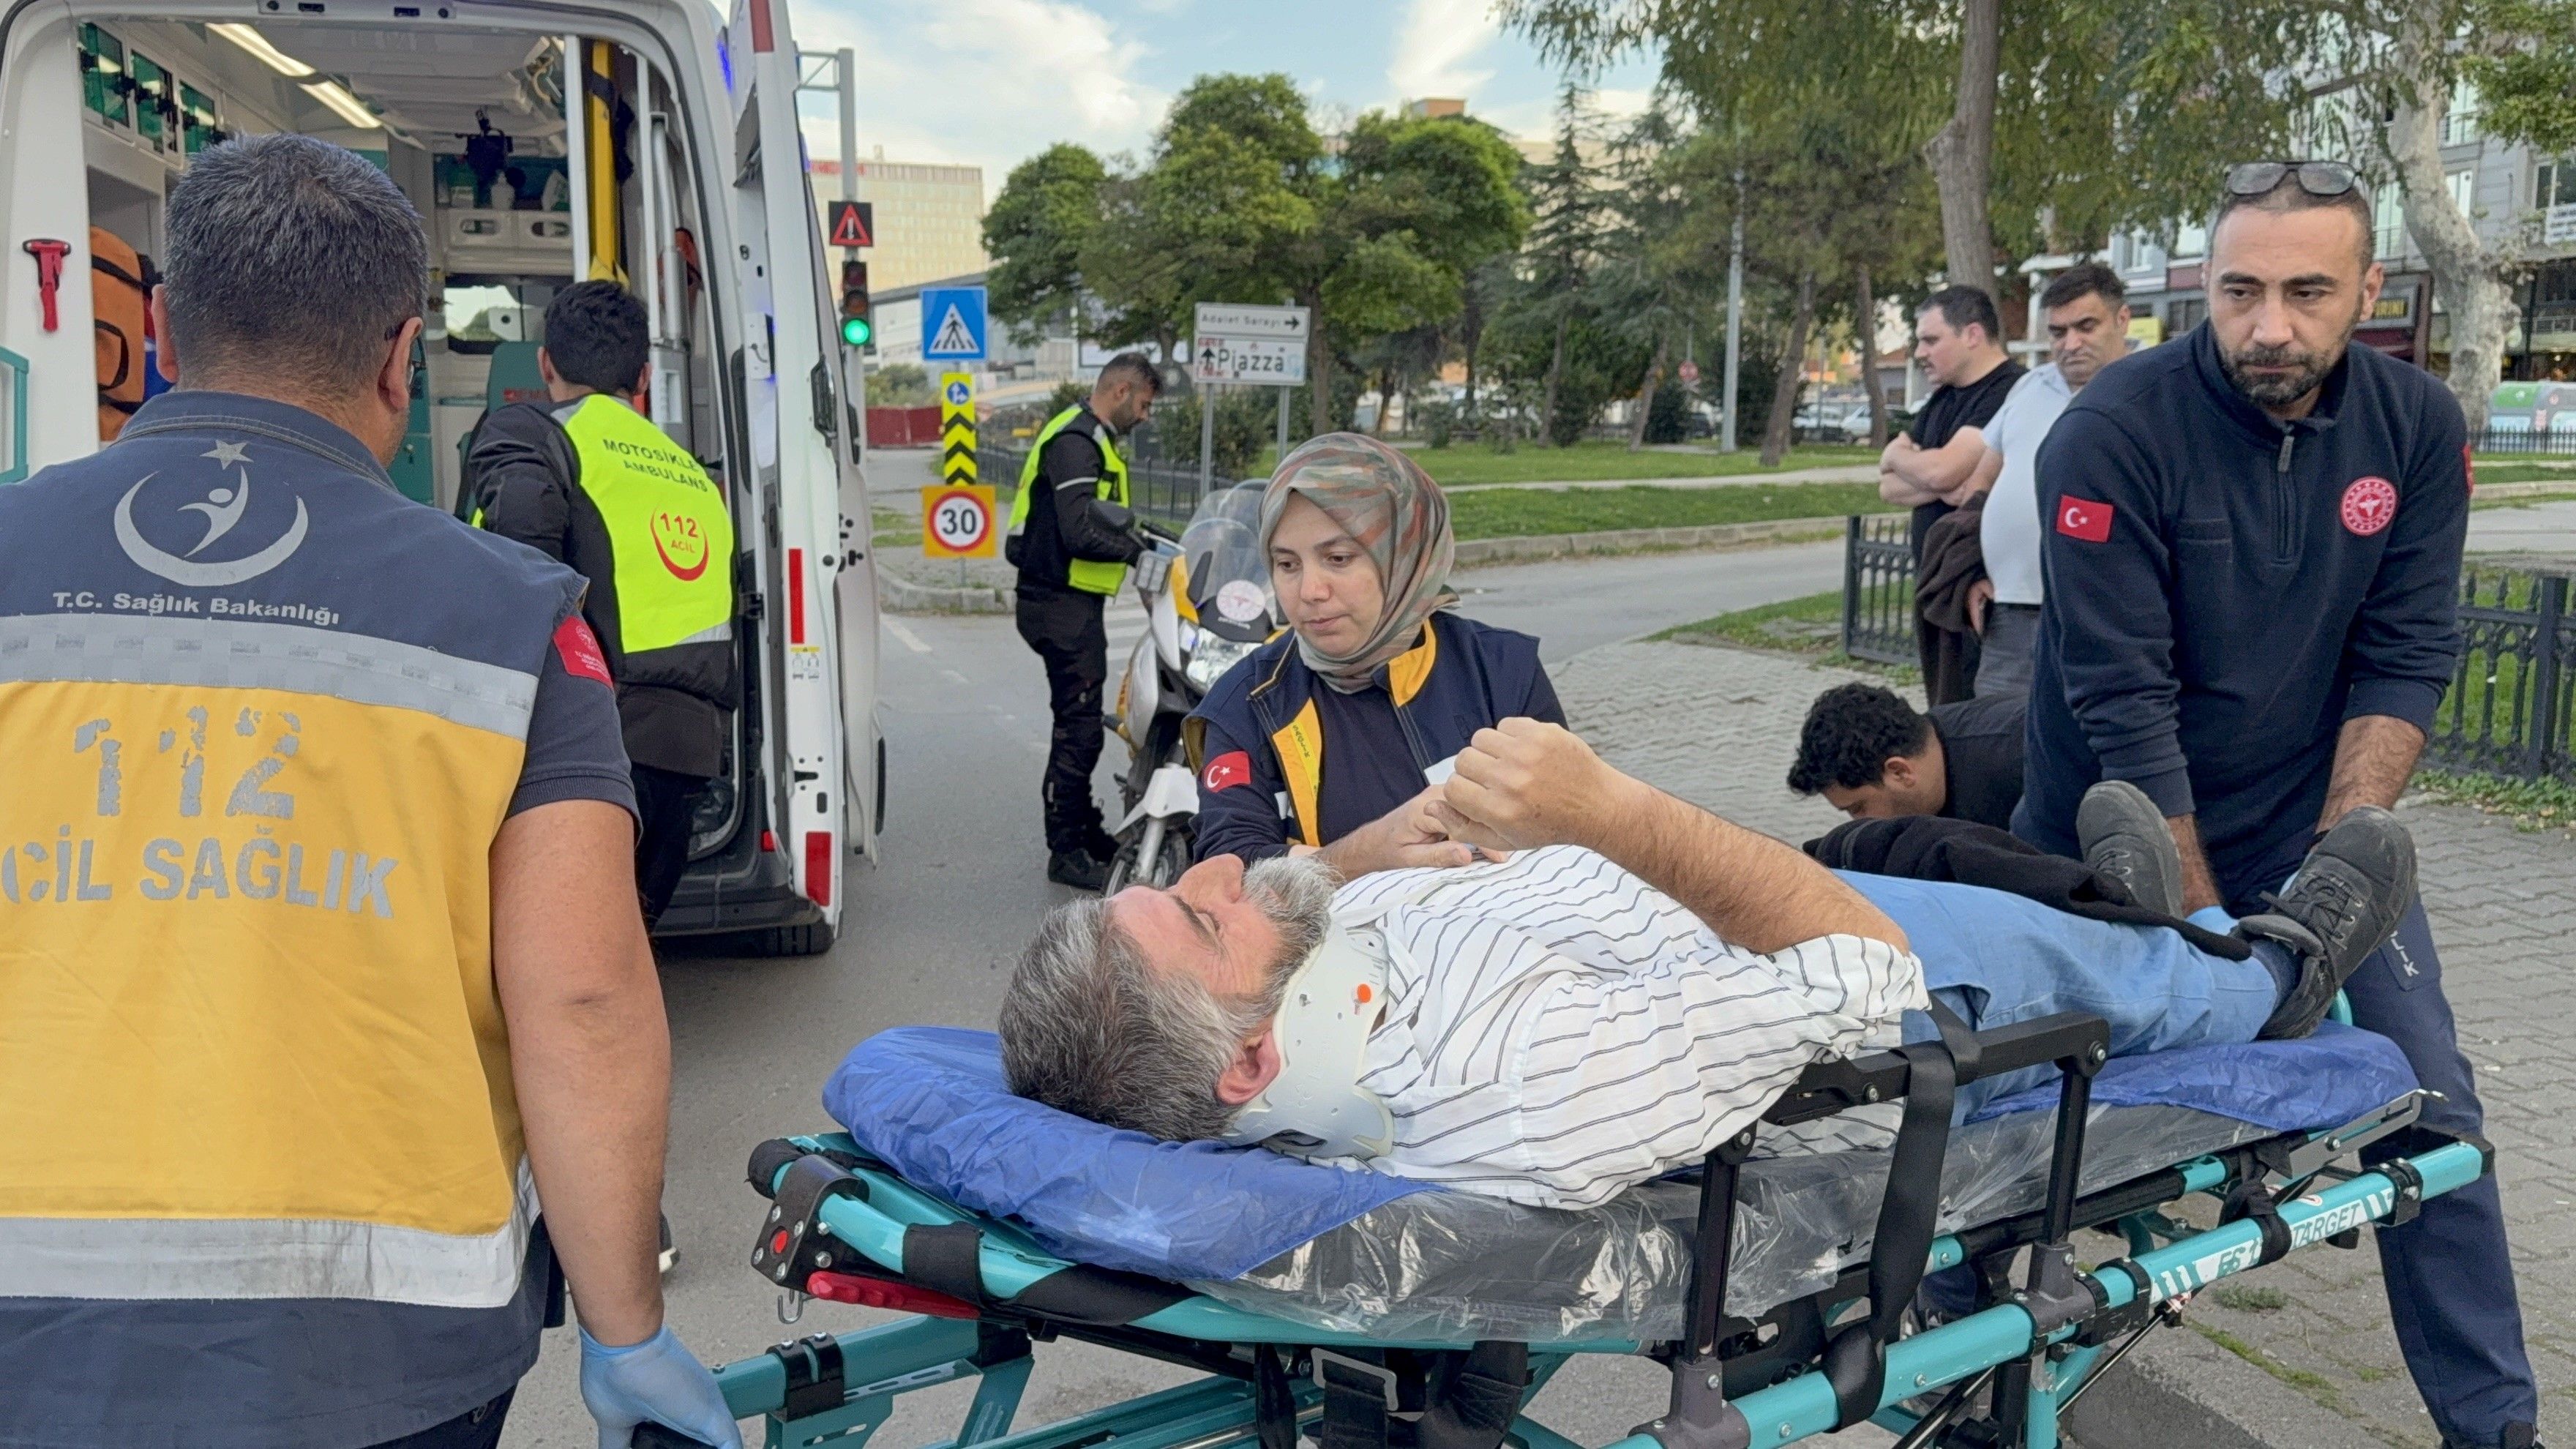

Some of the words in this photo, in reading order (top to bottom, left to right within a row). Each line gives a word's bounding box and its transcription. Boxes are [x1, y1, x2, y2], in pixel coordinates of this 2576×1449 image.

[1218, 348, 1284, 372] Piazza
[602, 438, 700, 473] MOTOSİKLE
[623, 459, 708, 493] AMBULANS
[660, 512, 699, 539] 112
[942, 508, 977, 536] 30
[670, 539, 696, 554] ACİL
[53, 591, 102, 609] T.C.
[113, 593, 199, 613] Sağlık
[209, 598, 340, 626] Bakanlığı
[75, 705, 302, 820] 112
[1, 824, 113, 904] CİL
[139, 824, 400, 919] SAĞLIK
[2292, 1202, 2361, 1248] TARGET
